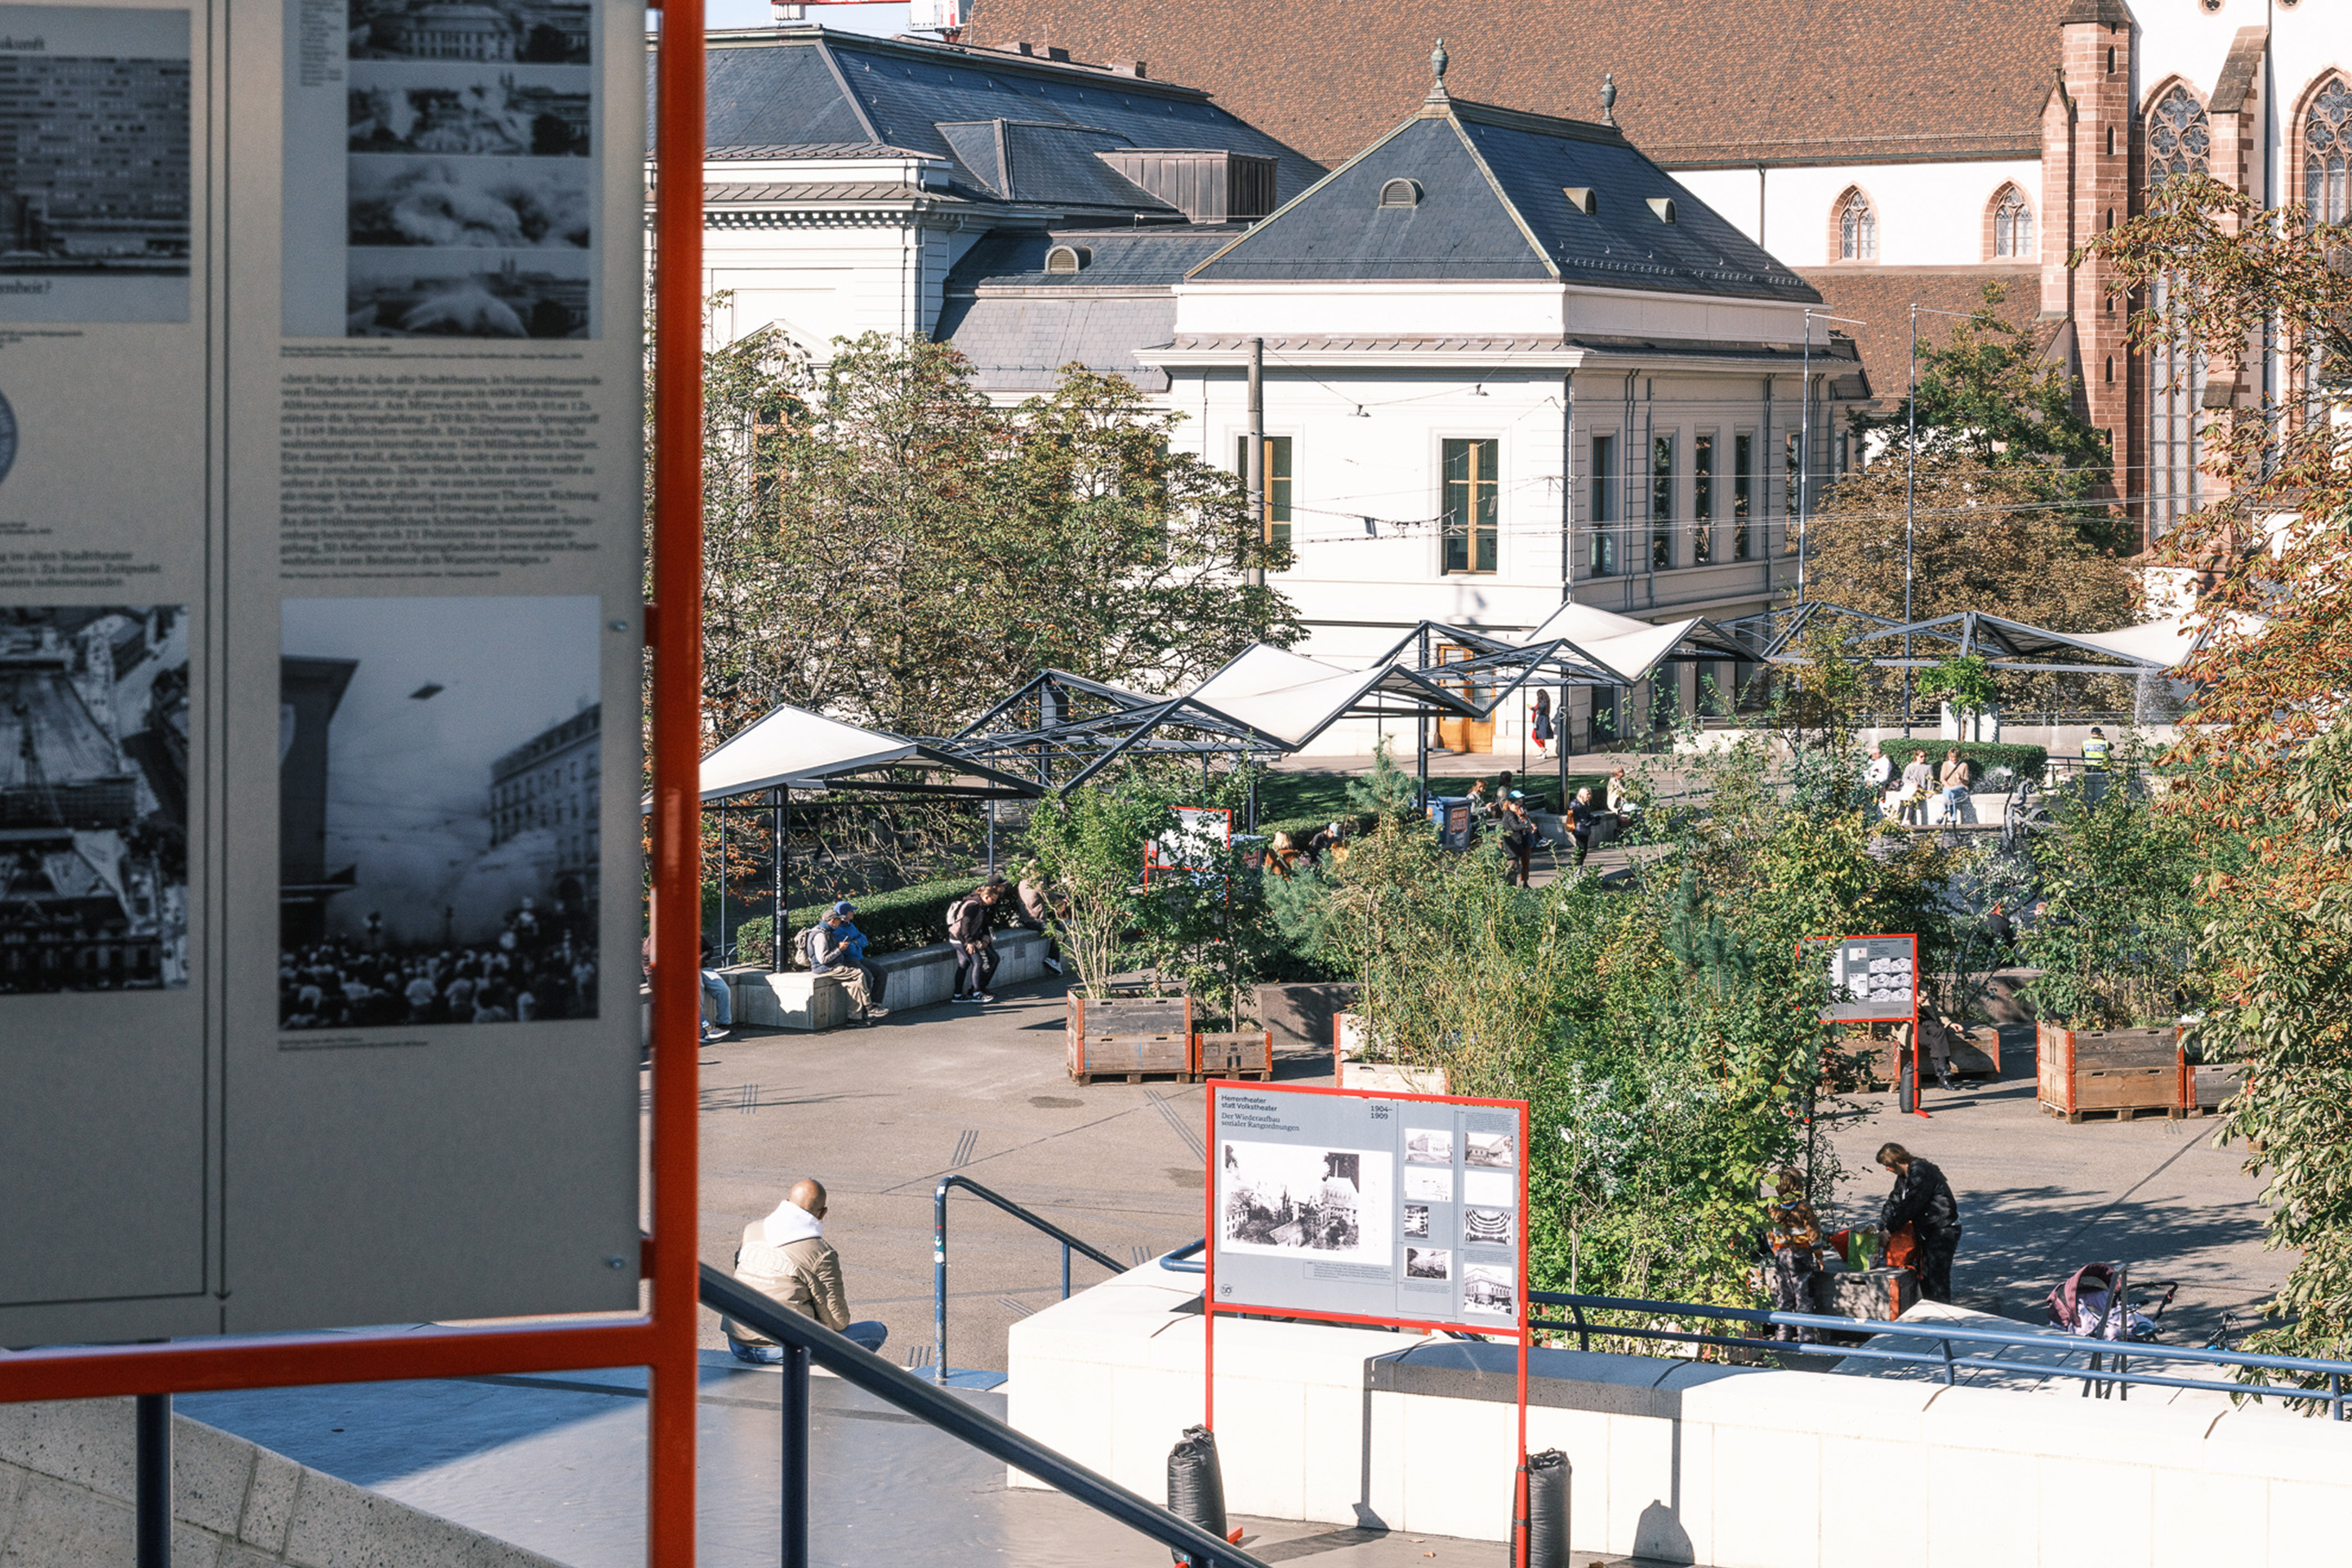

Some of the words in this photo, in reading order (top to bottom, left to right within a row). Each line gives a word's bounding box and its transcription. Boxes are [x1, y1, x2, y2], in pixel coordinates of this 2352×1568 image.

[1221, 1095, 1266, 1103] Herrentheater
[1236, 1102, 1277, 1111] Volkstheater
[1235, 1113, 1281, 1123] Wiederaufbau
[1248, 1121, 1299, 1132] Rangordnungen
